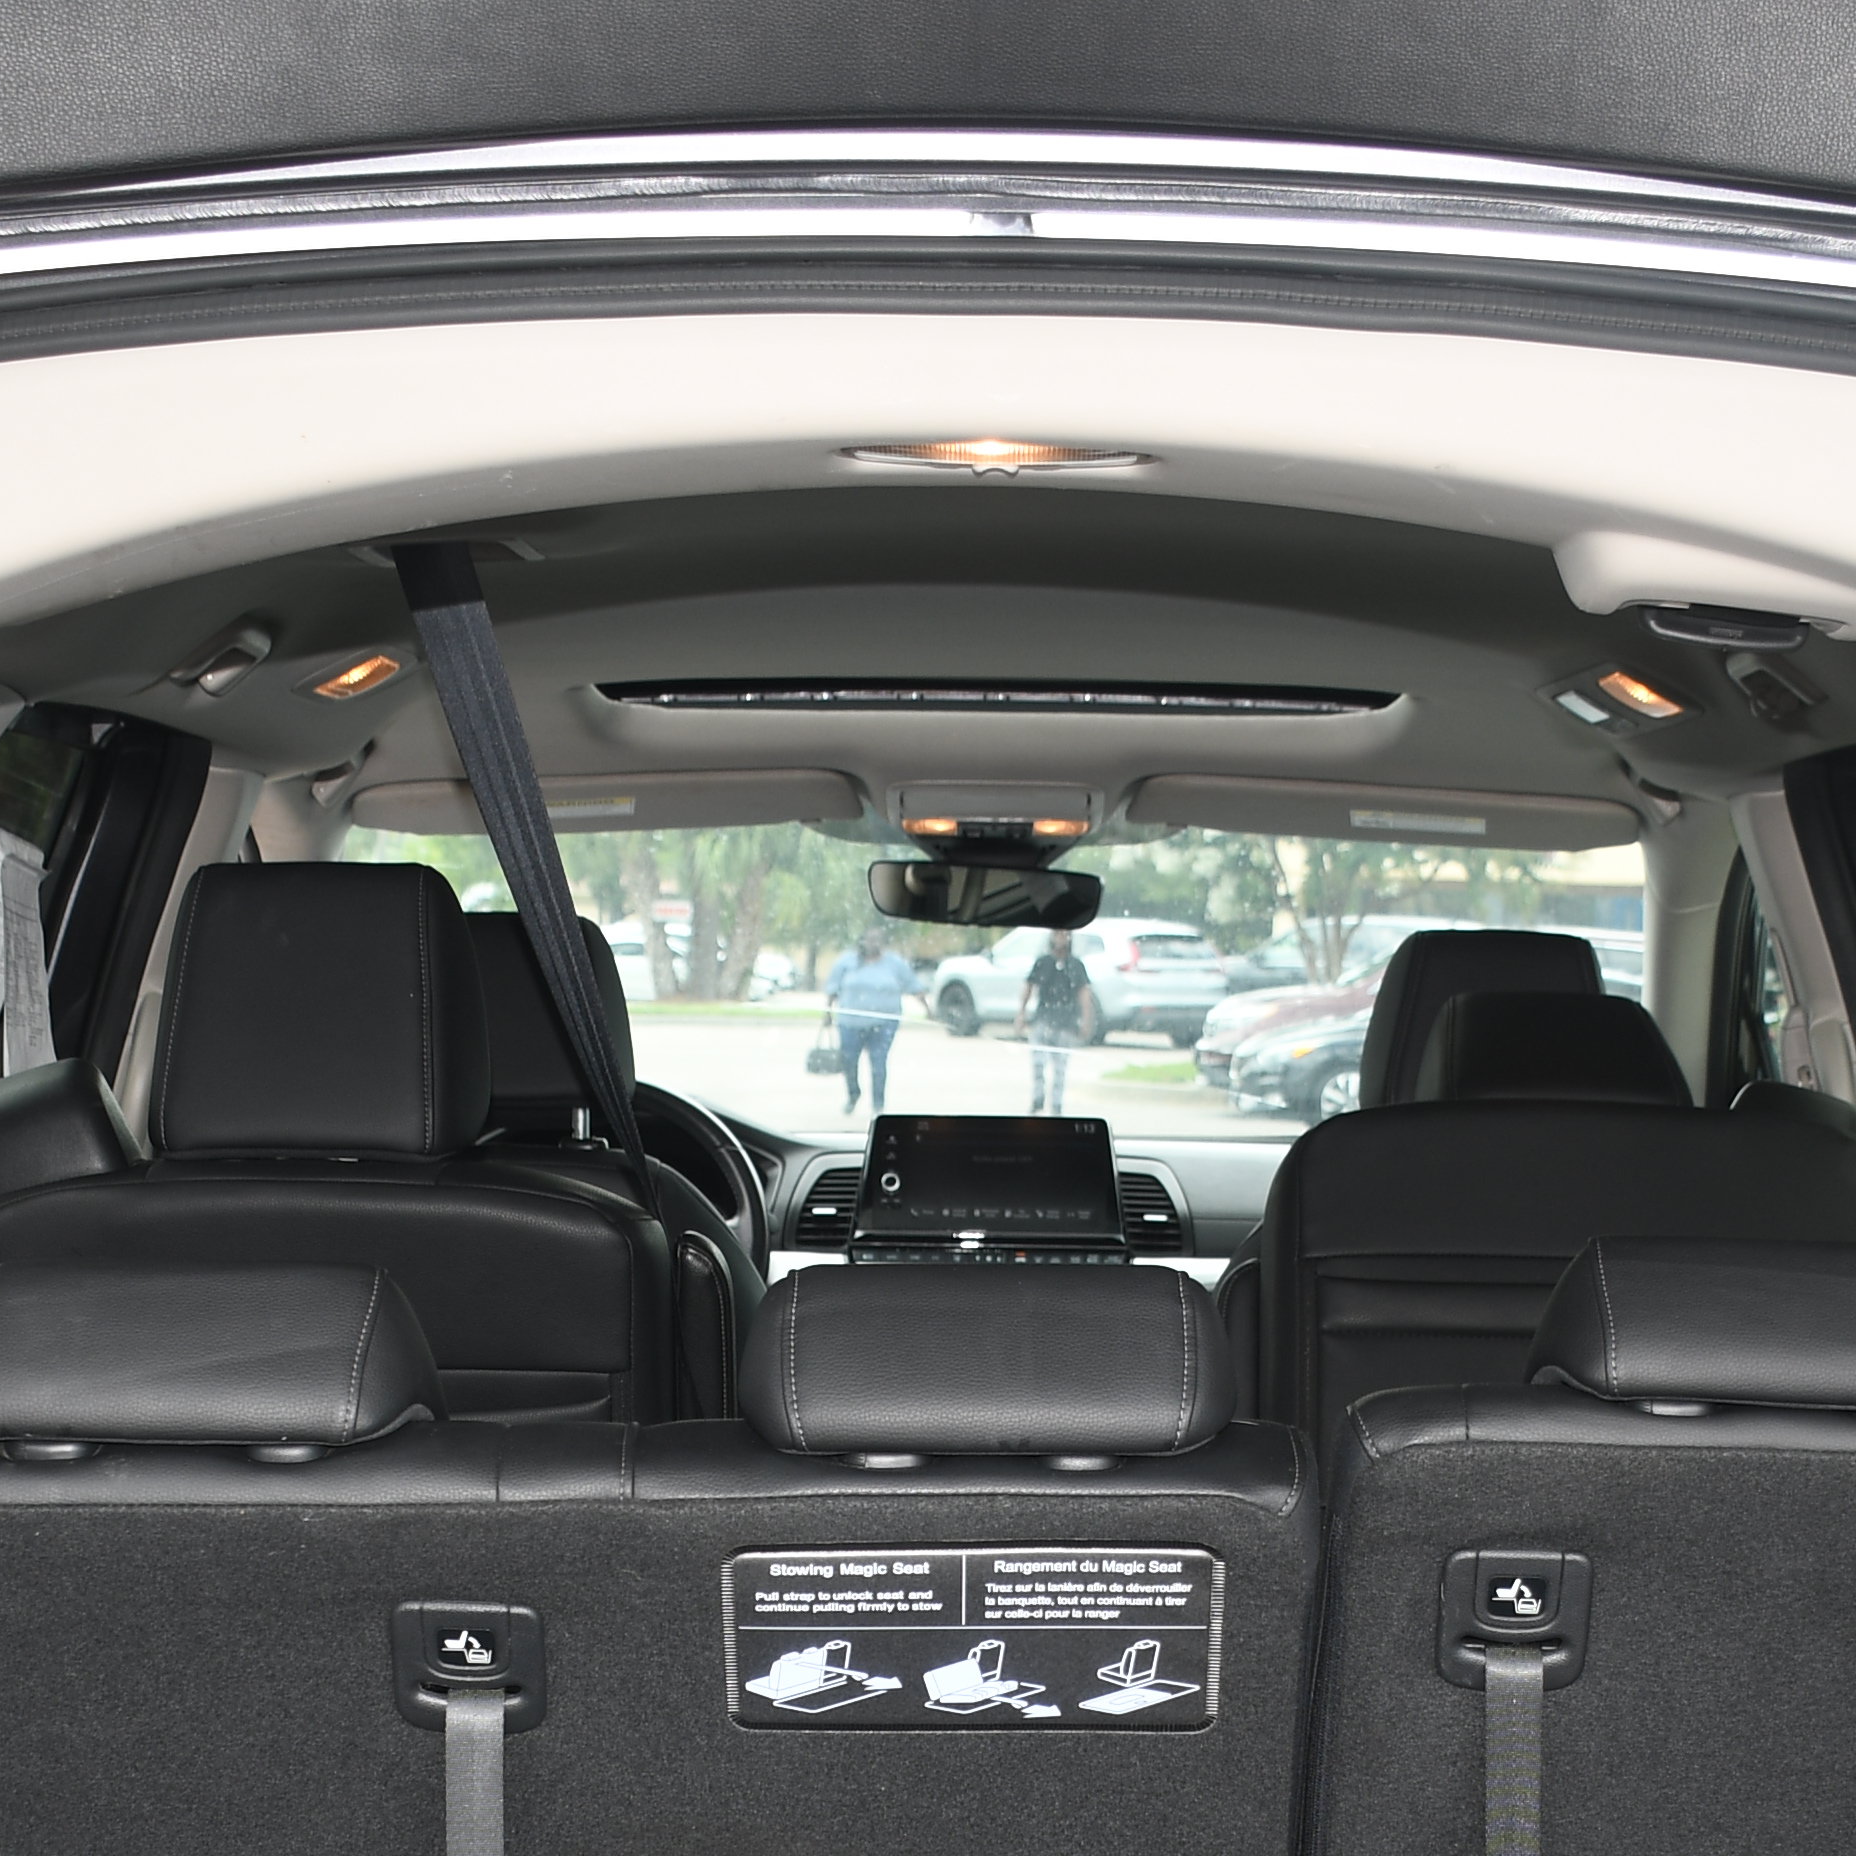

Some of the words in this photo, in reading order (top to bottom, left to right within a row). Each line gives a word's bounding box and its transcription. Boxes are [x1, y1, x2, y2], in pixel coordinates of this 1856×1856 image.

[769, 1563, 834, 1578] Stowing
[839, 1562, 888, 1577] Magic
[892, 1561, 931, 1575] Seat
[993, 1560, 1078, 1575] Rangement
[1079, 1559, 1100, 1573] du
[1101, 1560, 1146, 1575] Magic
[1148, 1560, 1183, 1573] Seat
[984, 1582, 1014, 1593] Tirez
[1014, 1583, 1034, 1593] sur
[1034, 1582, 1046, 1593] la
[1086, 1582, 1108, 1593] afin
[1108, 1582, 1125, 1593] de
[754, 1592, 780, 1602] Pull
[782, 1592, 816, 1603] strap
[817, 1591, 832, 1601] to
[832, 1590, 874, 1601] unlock
[876, 1590, 905, 1600] seat
[907, 1589, 934, 1600] and
[984, 1596, 996, 1606] la
[1056, 1596, 1079, 1606] tout
[1079, 1597, 1096, 1606] en
[1096, 1596, 1154, 1606] continuant
[1164, 1596, 1188, 1606] tirer
[754, 1602, 810, 1613] continue
[812, 1602, 856, 1614] pulling
[857, 1601, 896, 1613] firmly
[897, 1601, 910, 1611] to
[911, 1601, 944, 1611] stow
[984, 1610, 1003, 1619] sur
[1044, 1609, 1071, 1620] pour
[1071, 1608, 1083, 1618] la
[1084, 1609, 1121, 1620] ranger
